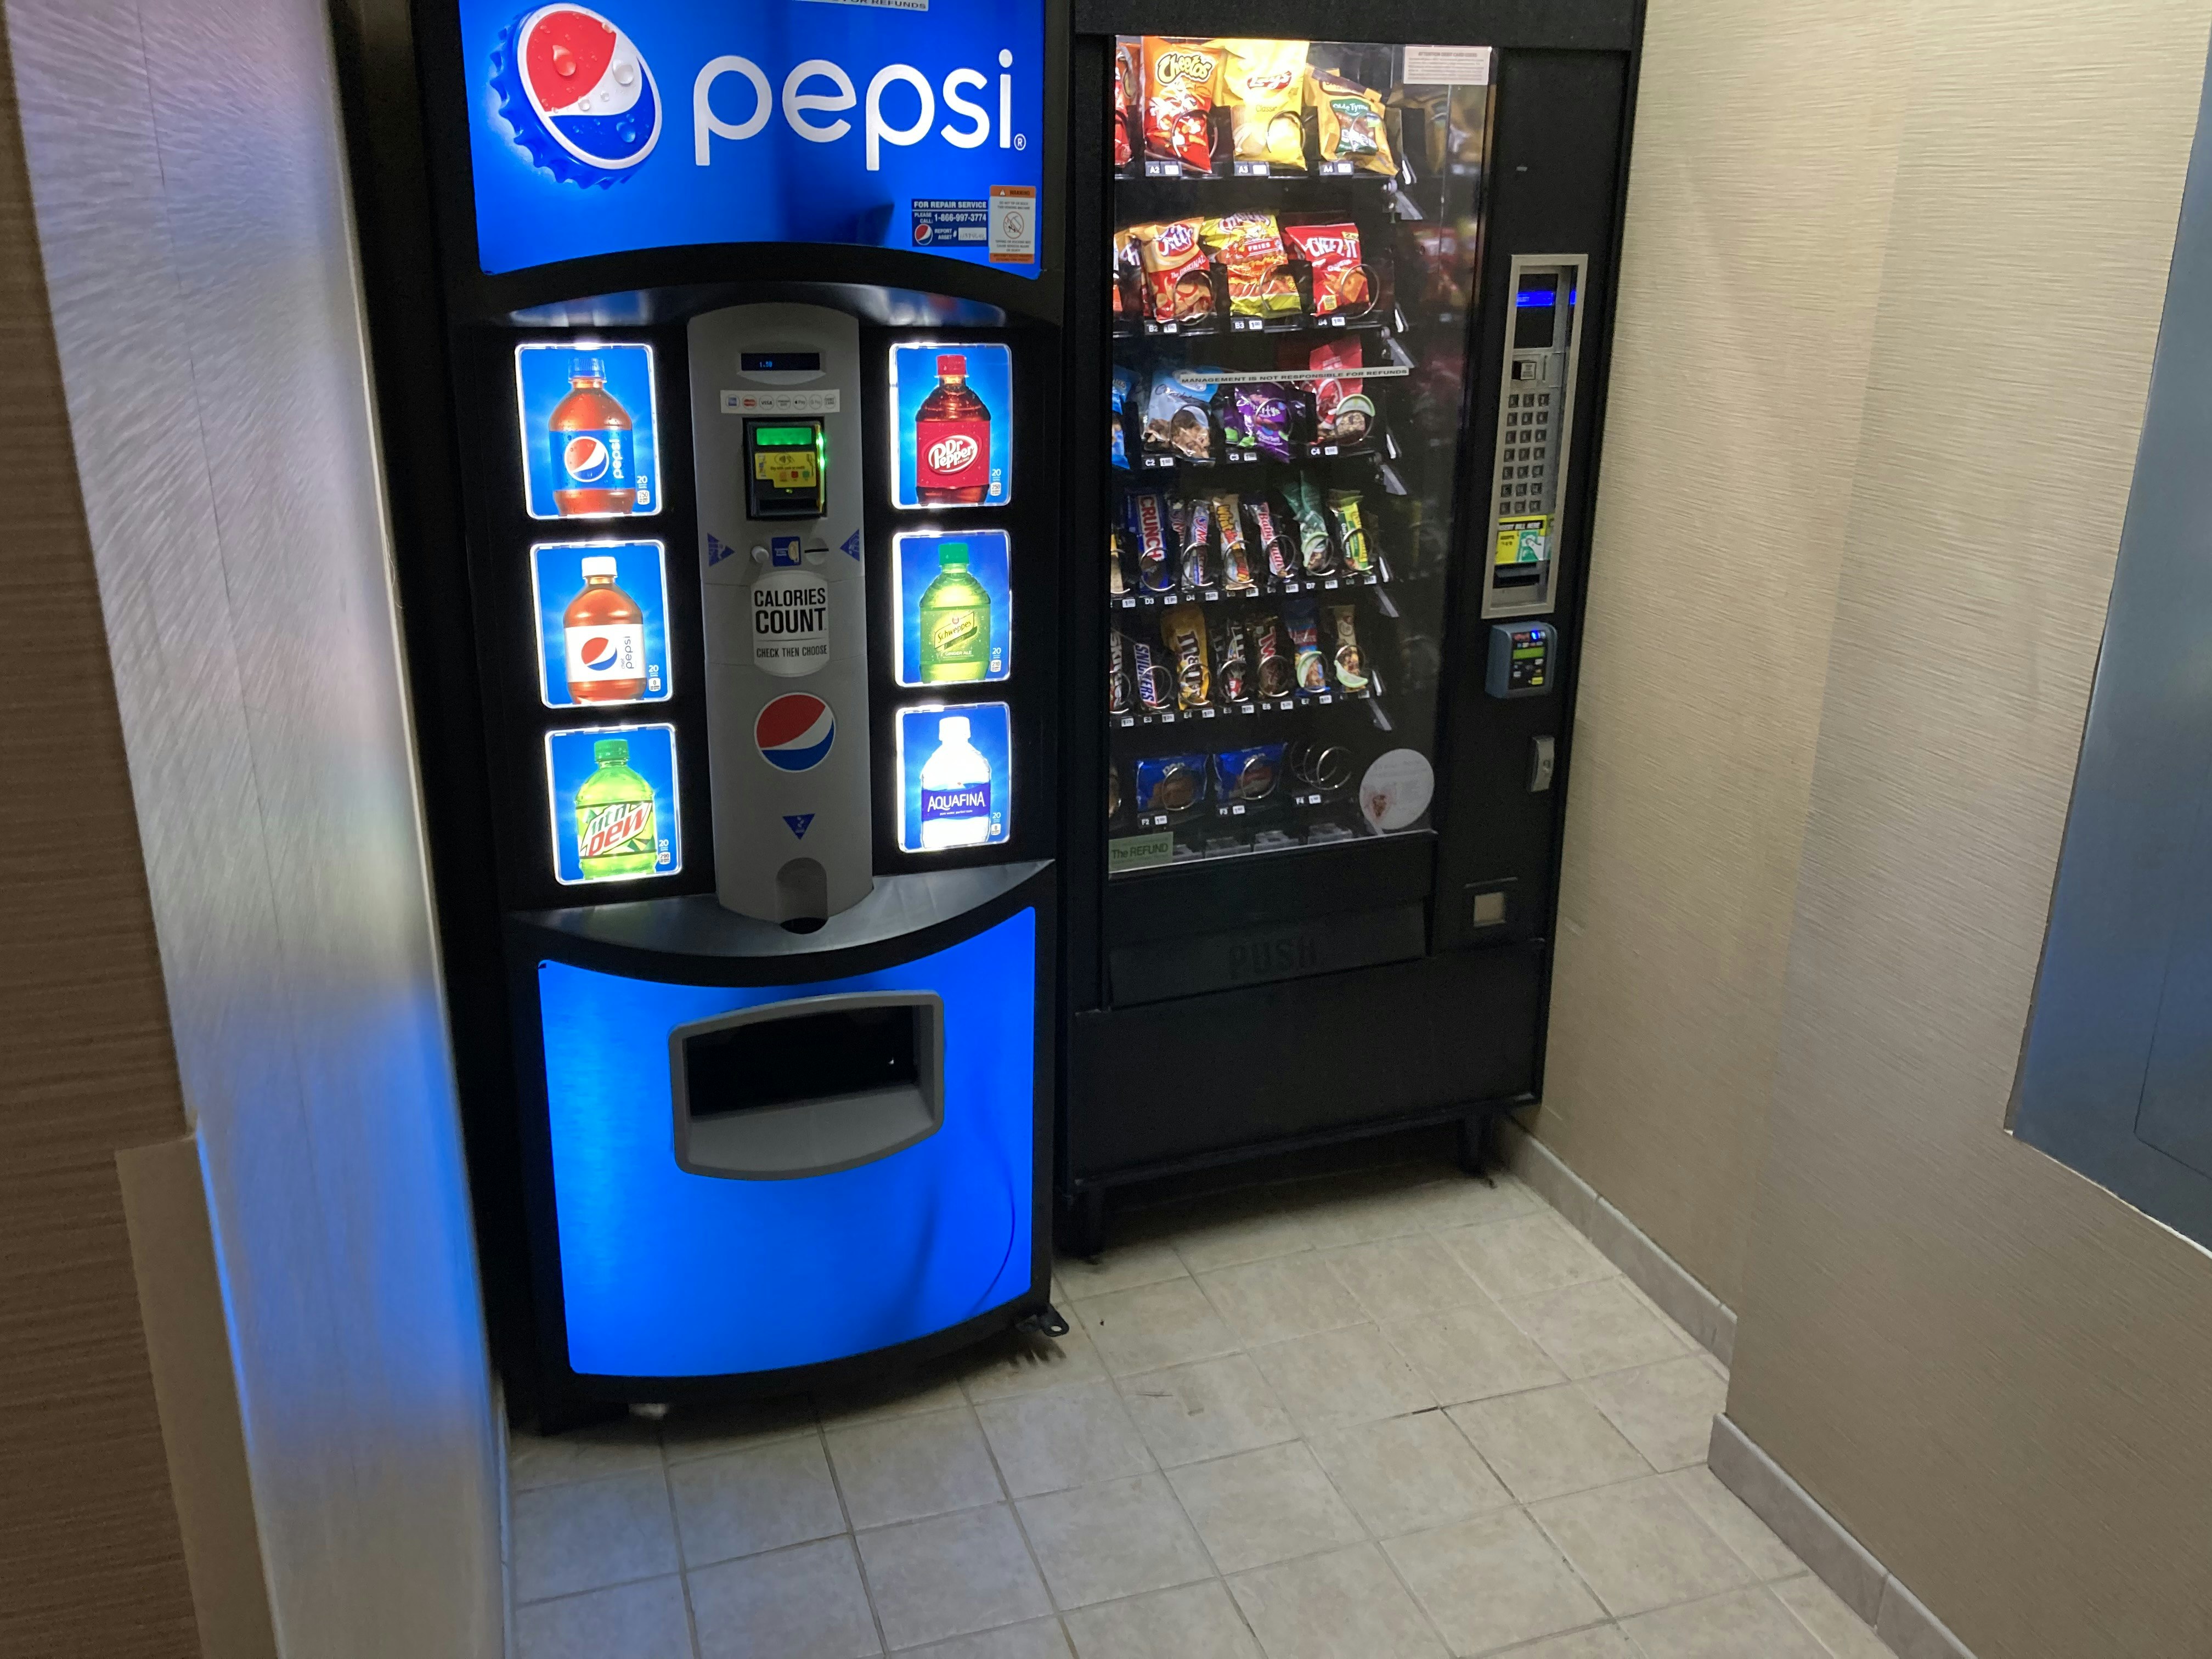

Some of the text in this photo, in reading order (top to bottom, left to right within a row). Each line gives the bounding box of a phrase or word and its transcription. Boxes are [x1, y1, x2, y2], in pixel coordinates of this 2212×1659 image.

[1158, 53, 1213, 83] Cheetos
[693, 48, 1012, 171] pepsi
[934, 213, 986, 222] 1-866-997-3774
[1248, 242, 1271, 252] FRIES
[933, 443, 974, 470] Pepper
[946, 439, 963, 456] Dr
[609, 439, 624, 479] pepsi
[637, 475, 648, 483] 20
[991, 469, 1001, 477] 20
[1139, 496, 1163, 561] CRUNCH
[754, 588, 826, 607] CALORIES
[755, 607, 826, 634] COUNT
[938, 620, 972, 644] Schweppes
[624, 636, 635, 669] pepsi
[757, 645, 827, 658] CHECK THEN CHOOSE
[648, 664, 659, 673] 20
[927, 791, 985, 812] AQUAFINA
[659, 839, 669, 848] 20
[1111, 843, 1169, 859] The REFUND
